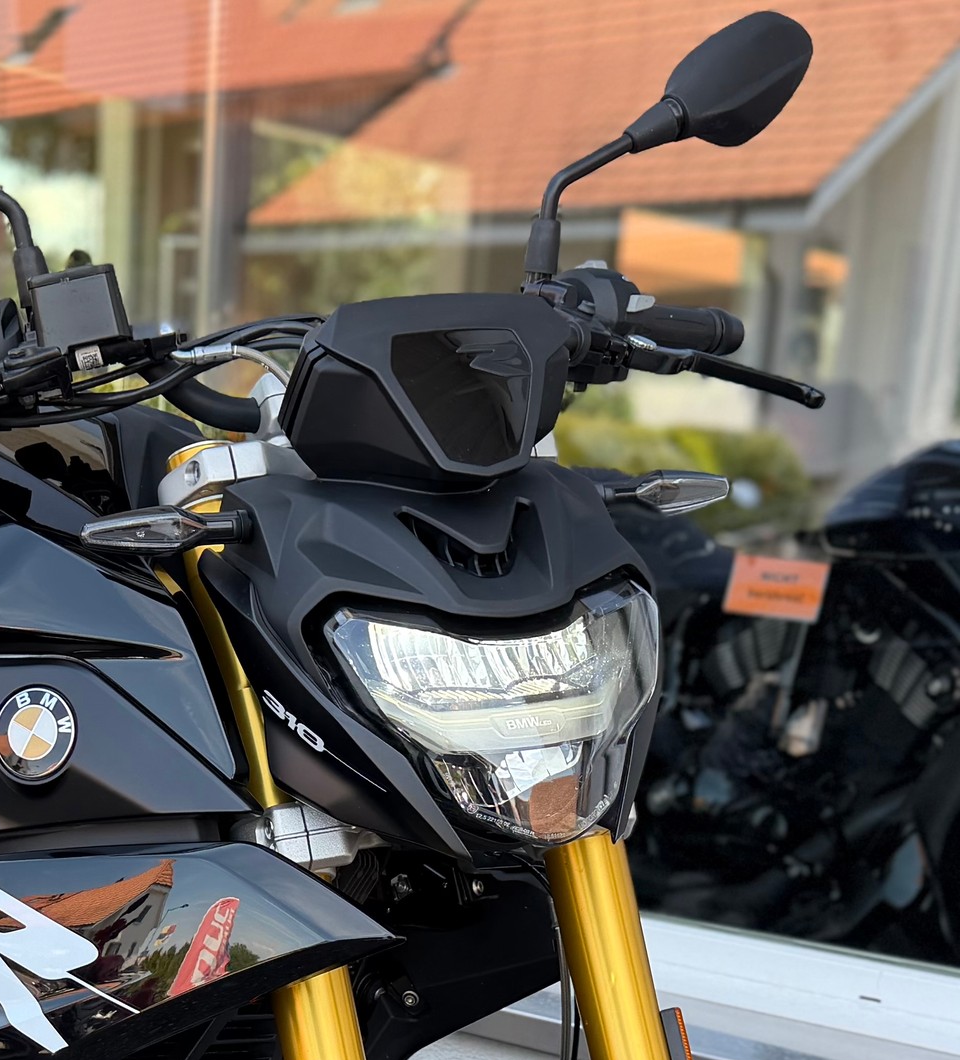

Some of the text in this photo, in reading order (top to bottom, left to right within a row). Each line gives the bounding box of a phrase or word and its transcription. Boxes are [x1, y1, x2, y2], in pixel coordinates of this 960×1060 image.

[15, 691, 73, 733] BMW
[262, 689, 325, 752] 310
[505, 715, 539, 730] BMW
